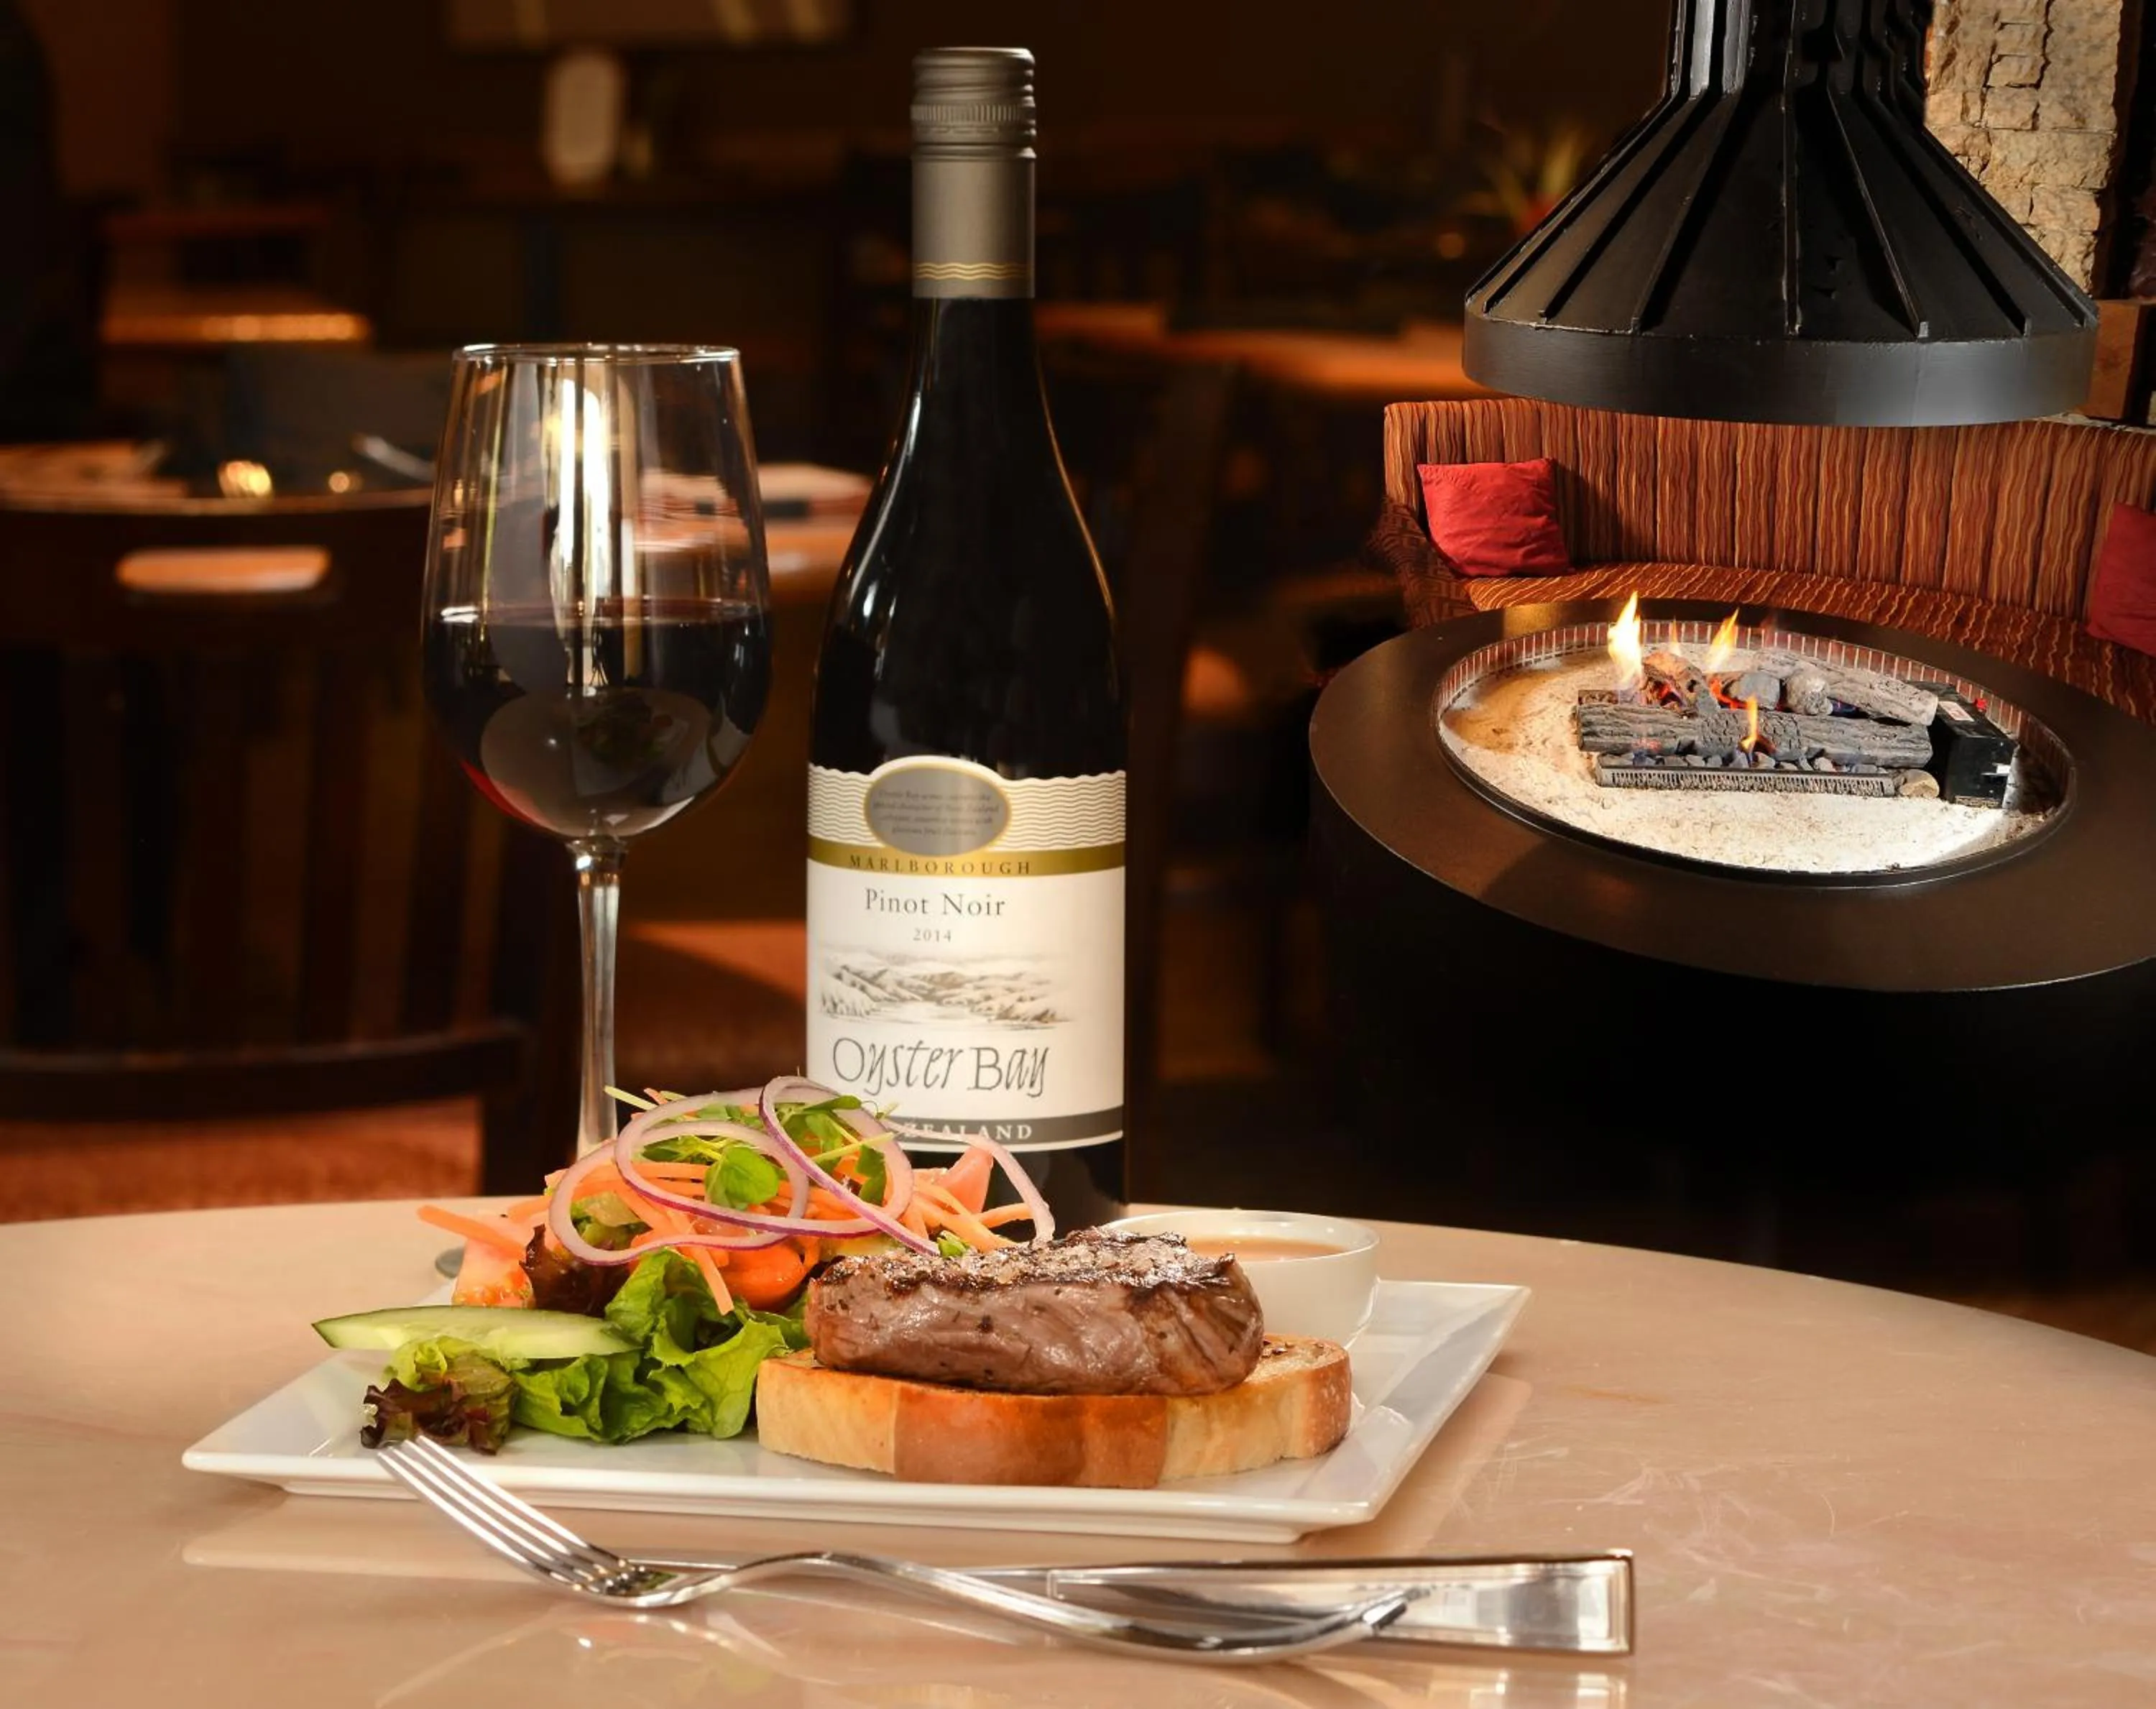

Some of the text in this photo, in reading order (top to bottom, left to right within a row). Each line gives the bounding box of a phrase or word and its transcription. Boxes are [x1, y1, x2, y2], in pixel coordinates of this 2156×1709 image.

[849, 854, 1031, 875] MARLBOROUGH
[865, 888, 1005, 916] Pinot Noir
[912, 928, 952, 942] 2014
[832, 1037, 1050, 1098] Oyster Bay
